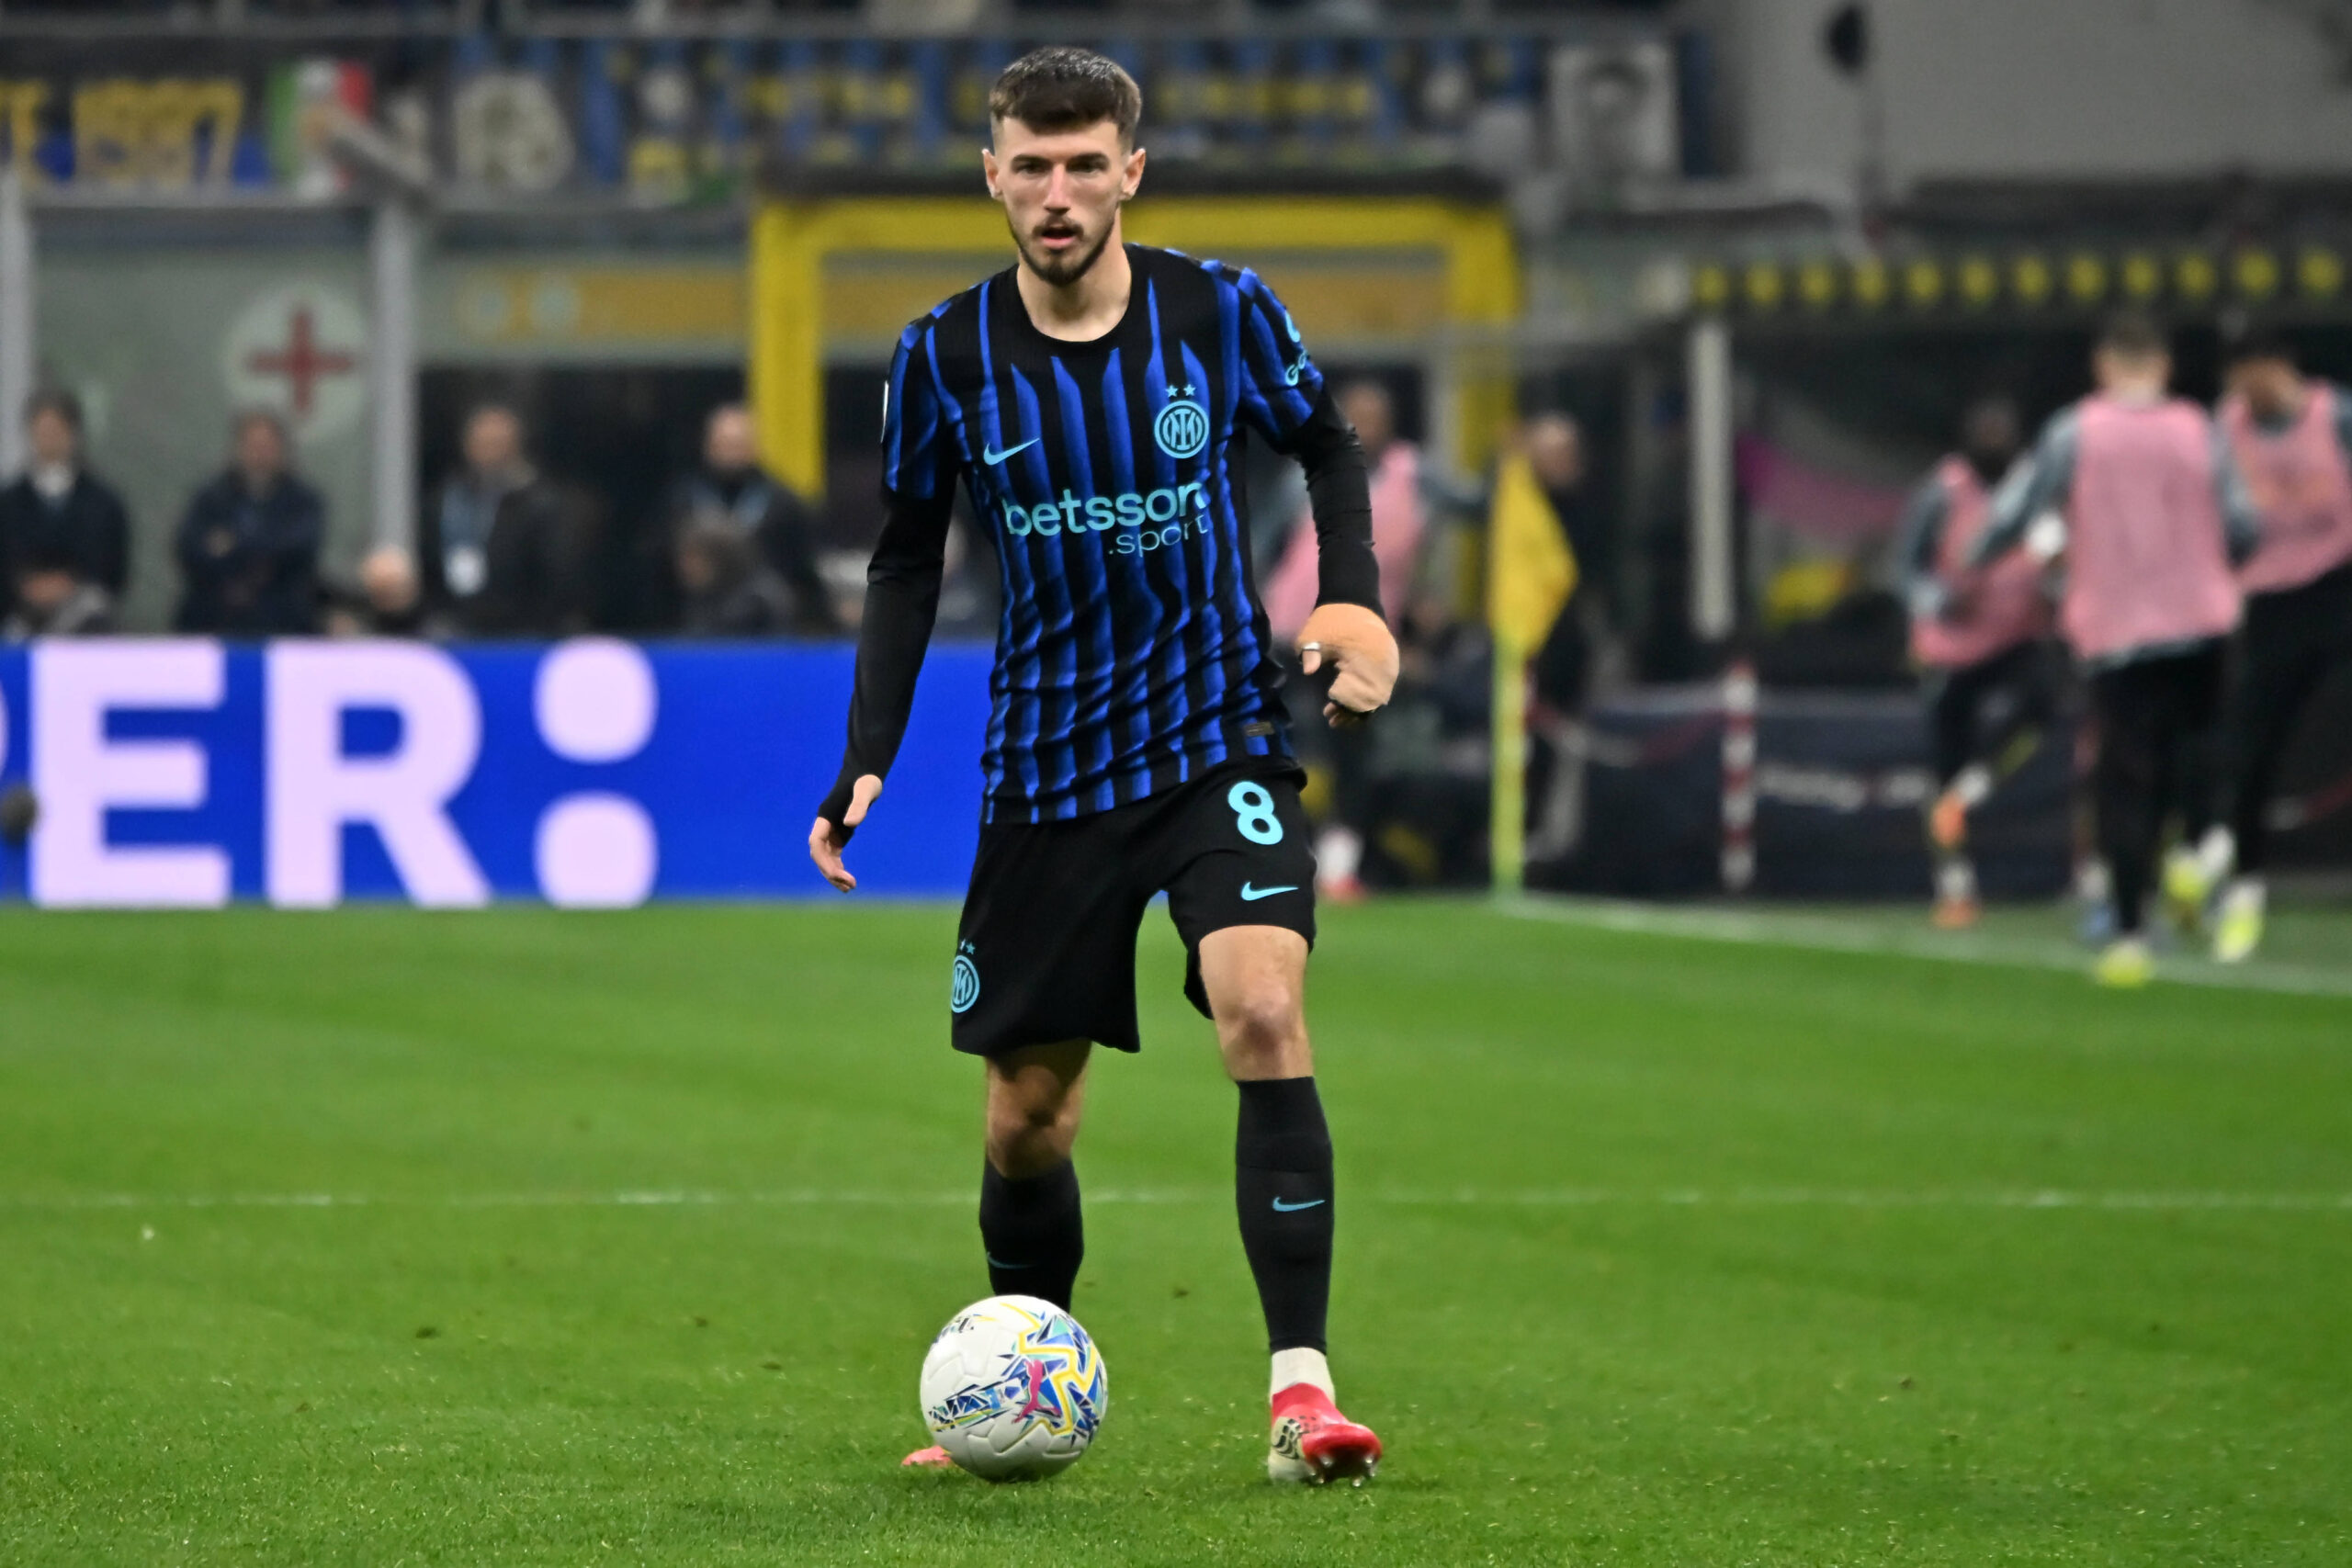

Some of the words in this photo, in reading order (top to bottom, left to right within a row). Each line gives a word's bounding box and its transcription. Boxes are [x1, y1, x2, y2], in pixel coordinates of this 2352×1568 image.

[1001, 481, 1207, 536] betsson
[1108, 514, 1208, 558] .sport
[0, 636, 659, 908] ER:
[1227, 781, 1283, 845] 8
